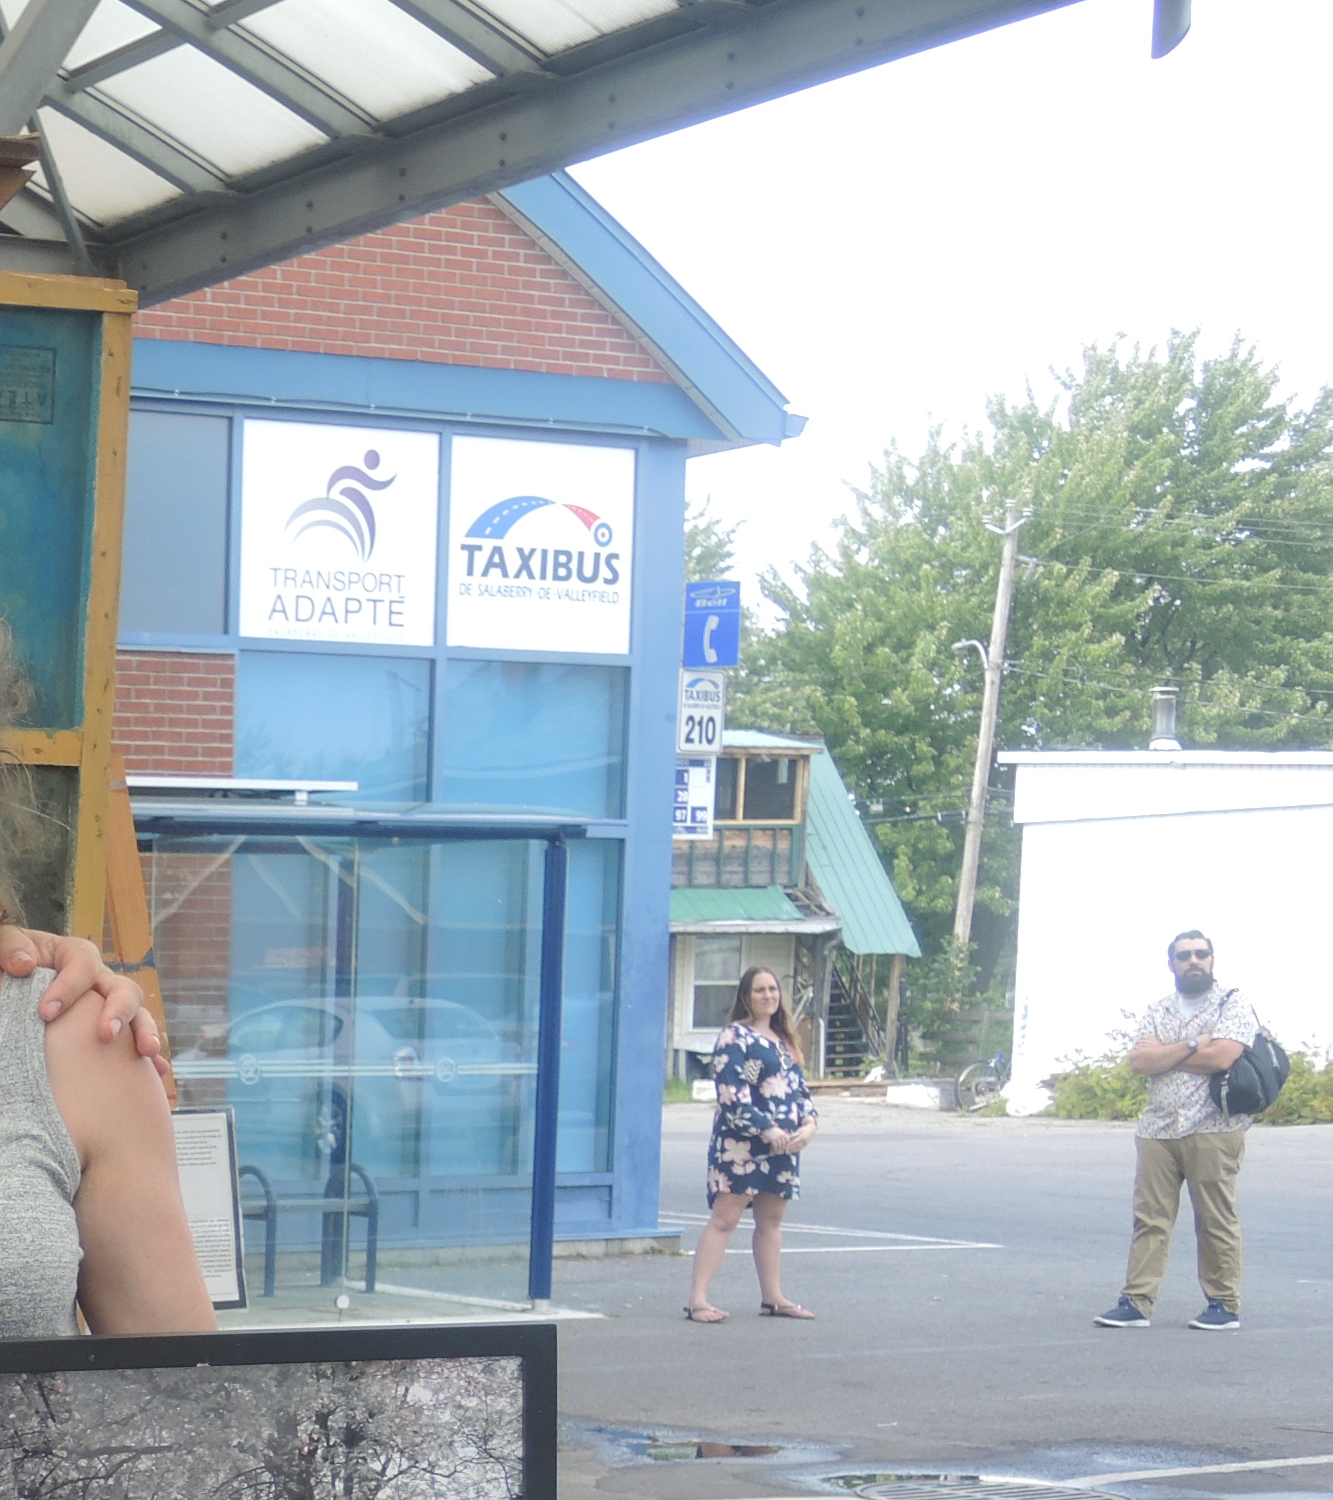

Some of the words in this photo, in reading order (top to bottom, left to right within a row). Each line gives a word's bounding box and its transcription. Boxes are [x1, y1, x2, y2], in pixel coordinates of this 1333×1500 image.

[460, 543, 621, 586] TAXIBUS
[268, 566, 406, 594] TRANSPORT
[268, 594, 406, 628] ADAPTÉ
[684, 689, 721, 702] TAXIBUS
[685, 715, 717, 745] 210
